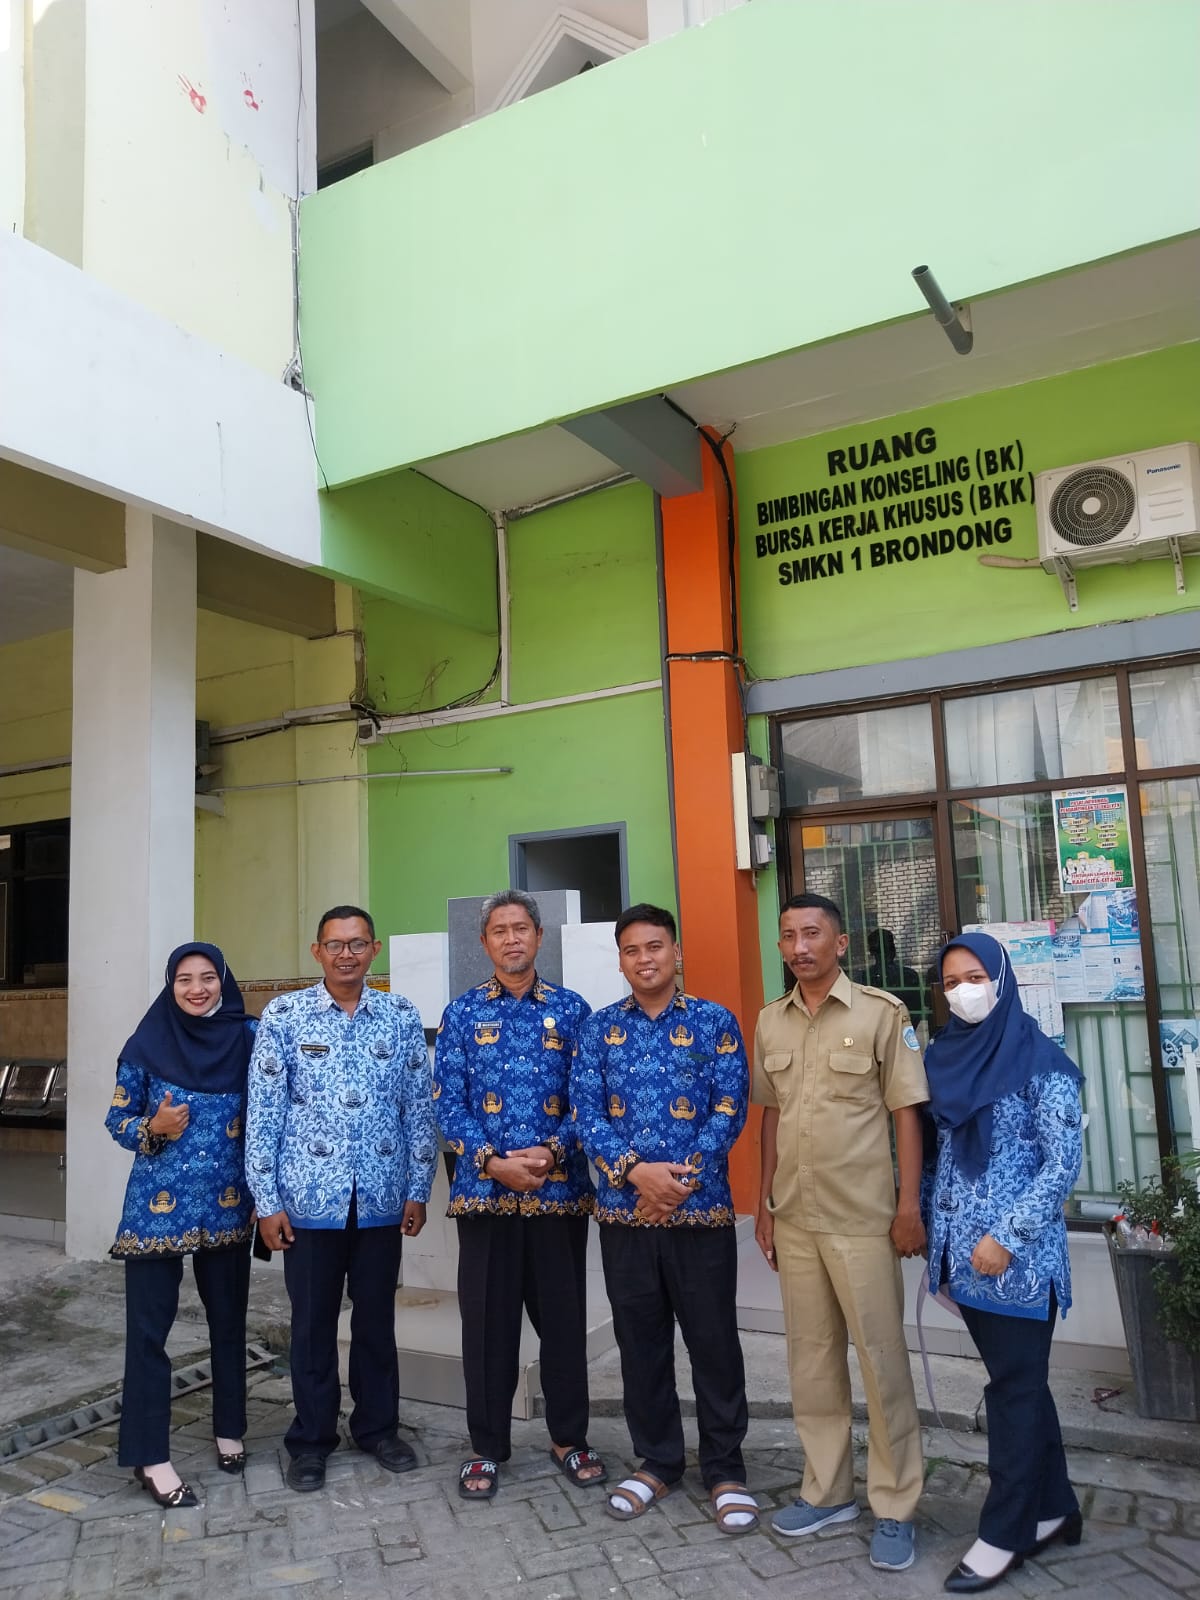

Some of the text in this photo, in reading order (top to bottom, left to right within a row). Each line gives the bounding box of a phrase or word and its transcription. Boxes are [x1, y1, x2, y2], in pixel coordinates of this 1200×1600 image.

[756, 439, 1024, 527] BIMBINGAN KONSELING (BK)
[827, 427, 937, 477] RUANG
[1146, 463, 1181, 475] Panasonic
[755, 471, 1036, 559] BURSA KERJA KHUSUS (BKK)
[778, 517, 1012, 586] SMKN 1 BRONDONG
